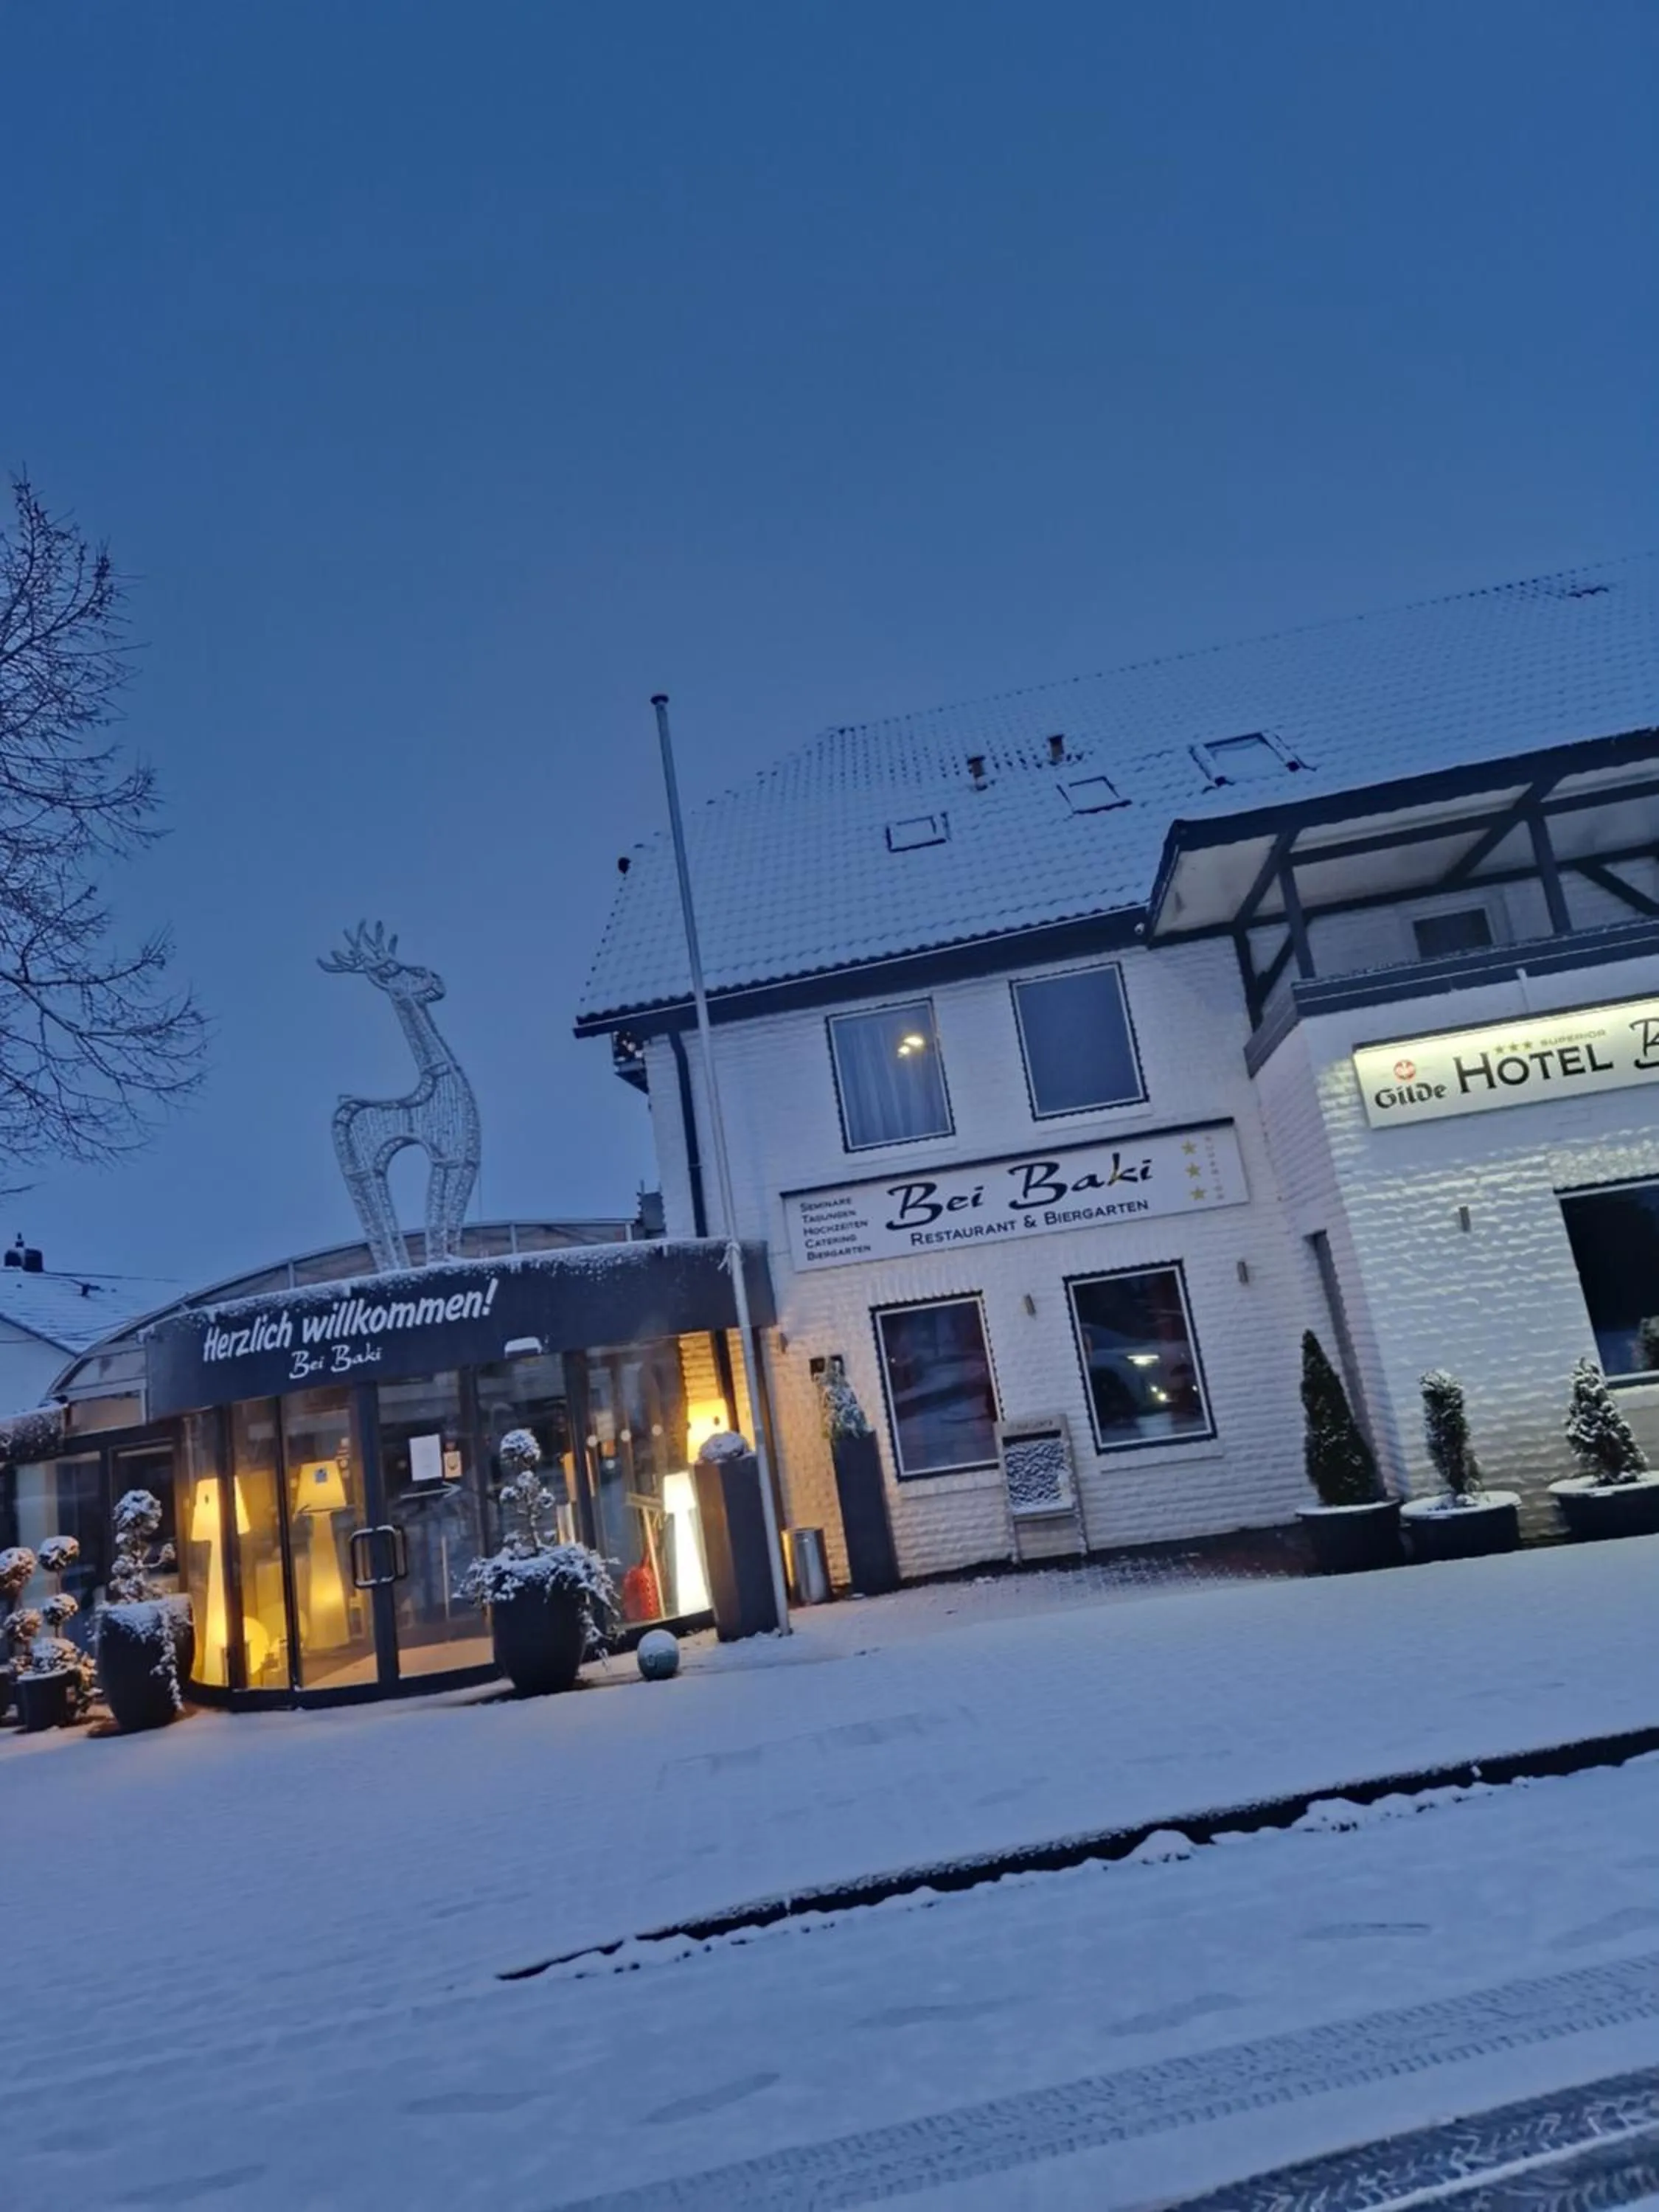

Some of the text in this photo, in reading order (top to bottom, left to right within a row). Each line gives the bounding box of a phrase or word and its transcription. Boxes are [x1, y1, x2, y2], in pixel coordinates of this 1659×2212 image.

[1374, 1082, 1447, 1109] Gilde
[1453, 1043, 1614, 1094] HOTEL
[886, 1181, 984, 1231] Bei
[1008, 1153, 1153, 1211] Baki
[804, 1234, 857, 1249] CATERING
[911, 1200, 1150, 1248] RESTAURANT & BIERGARTEN
[203, 1278, 499, 1363] Herzlich willkommen!
[289, 1343, 382, 1379] Bei Baki
